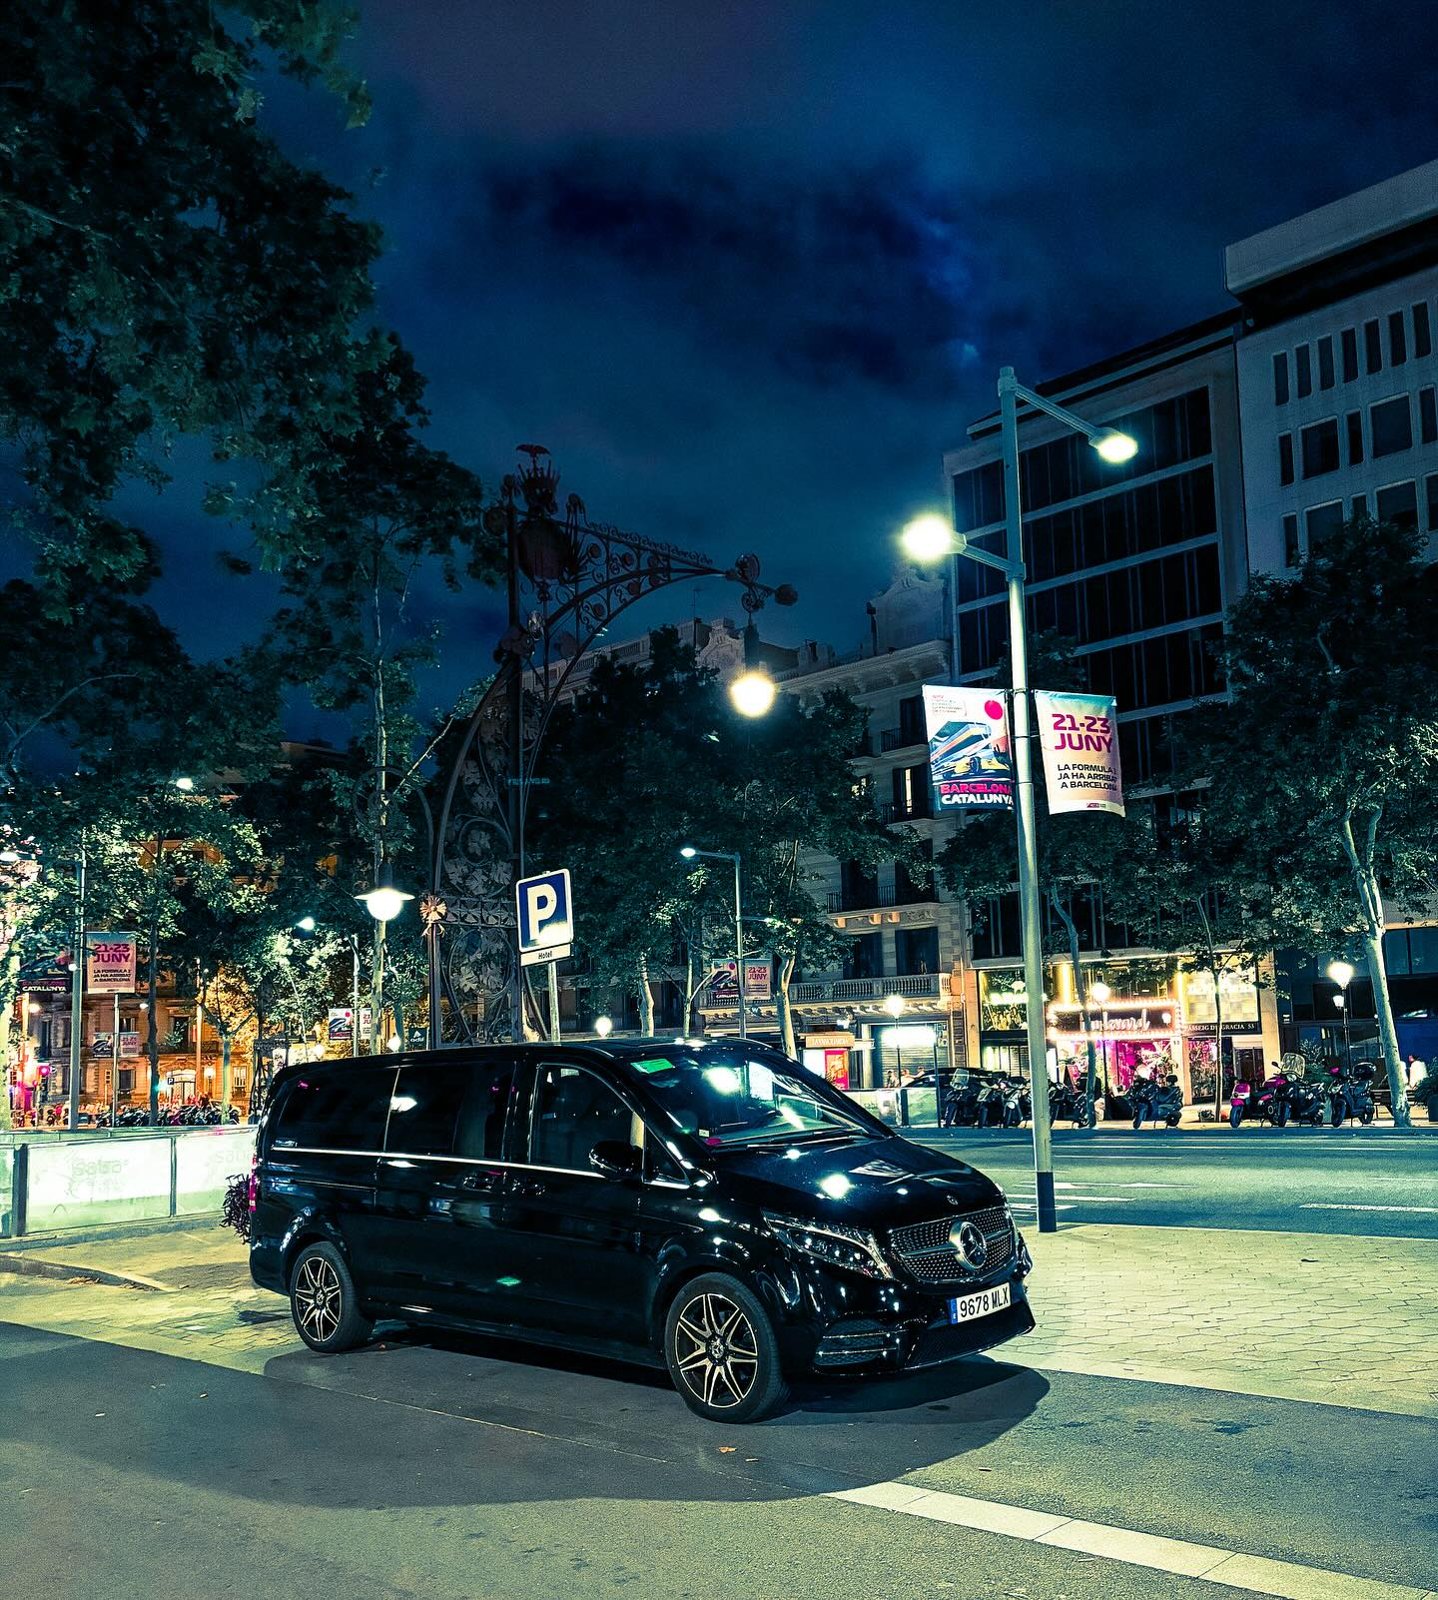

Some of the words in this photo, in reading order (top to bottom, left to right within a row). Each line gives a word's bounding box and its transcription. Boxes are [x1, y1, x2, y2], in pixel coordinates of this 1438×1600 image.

[1051, 713, 1111, 735] 21-23
[1054, 733, 1113, 754] JUNY
[1057, 763, 1071, 772] LA
[1072, 763, 1113, 774] FORMULA
[1057, 773, 1070, 781] JA
[1060, 781, 1069, 789] A
[941, 793, 1015, 806] CATALUNYA
[527, 883, 557, 941] P
[93, 952, 131, 963] JUNY
[538, 950, 553, 960] Hotel
[1184, 1024, 1210, 1032] ASSEIG
[960, 1294, 990, 1318] 9678
[991, 1286, 1009, 1309] MLX
